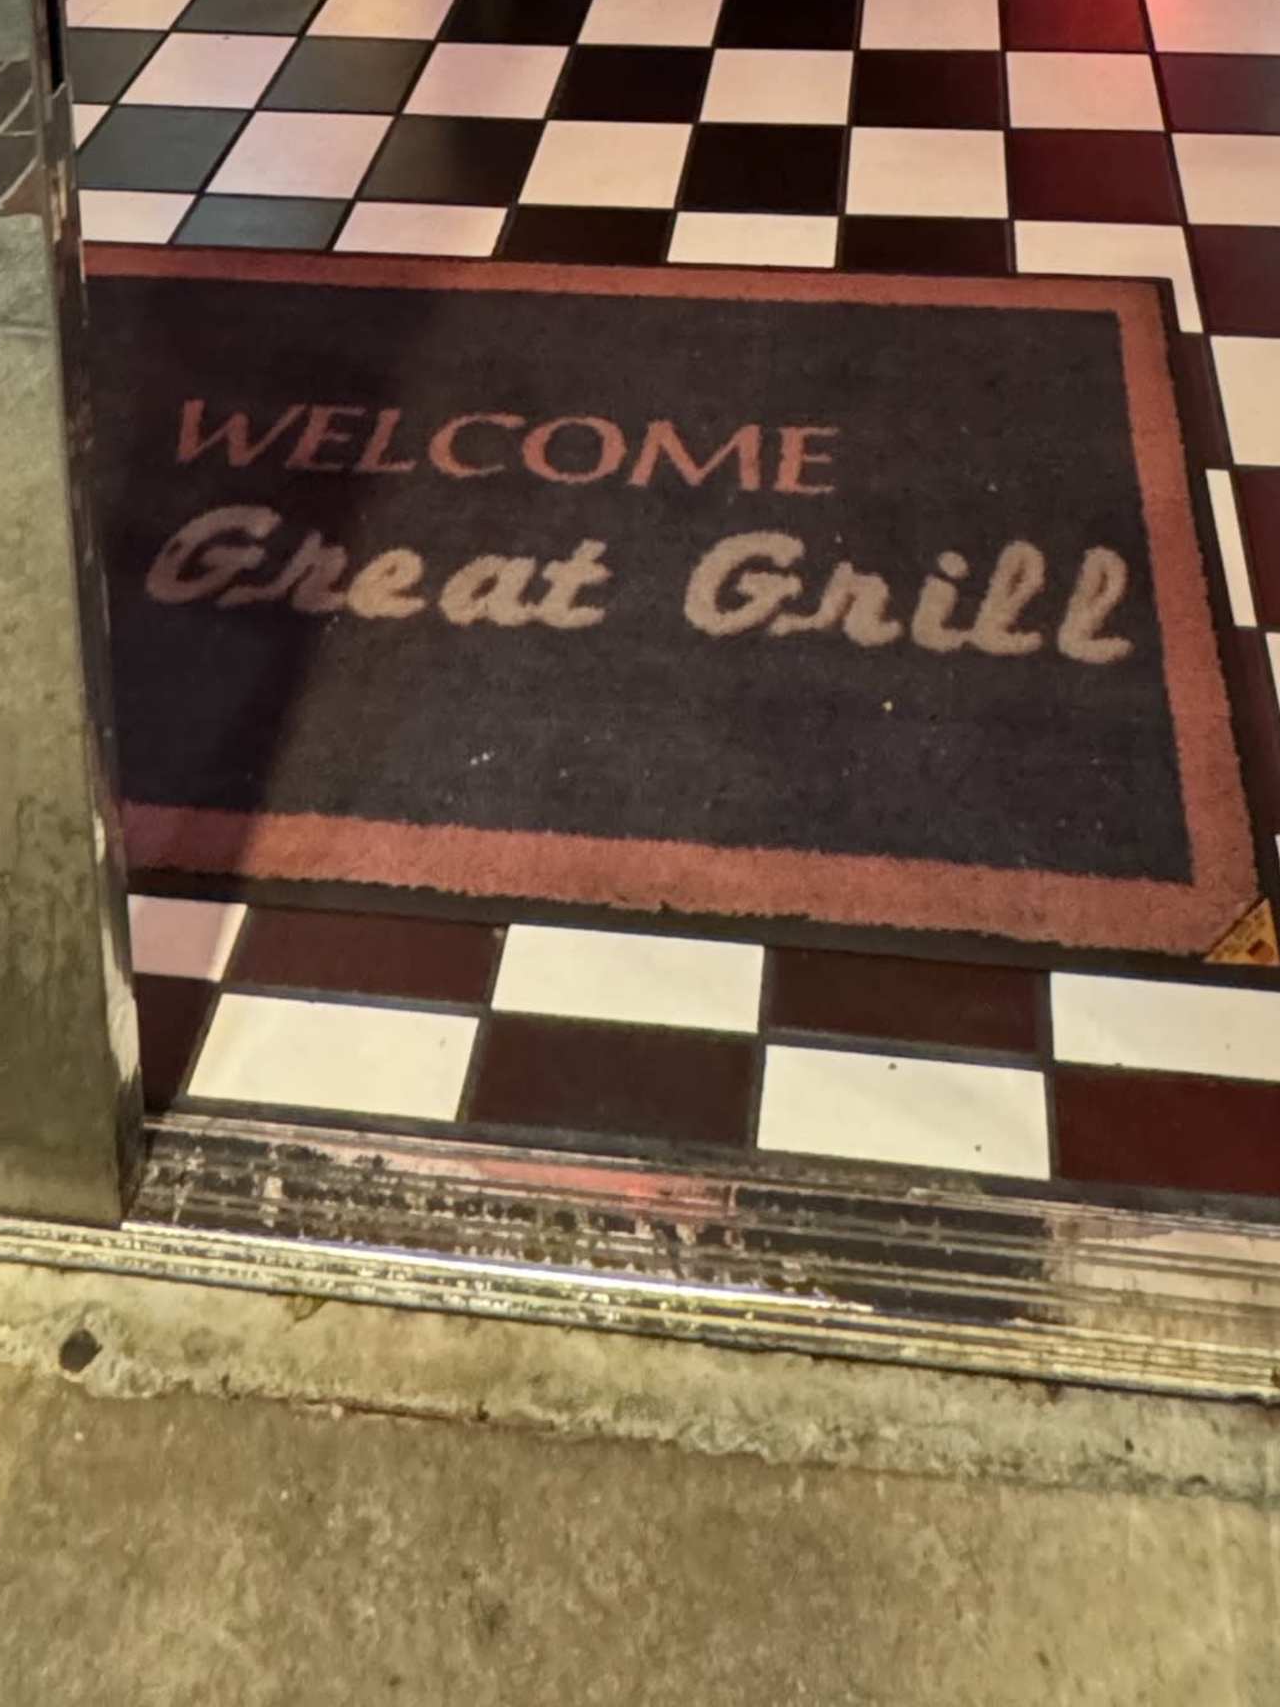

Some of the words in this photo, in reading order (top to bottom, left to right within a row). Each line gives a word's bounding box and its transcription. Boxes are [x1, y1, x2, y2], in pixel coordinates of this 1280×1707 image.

[174, 397, 841, 495] WELCOME
[145, 503, 613, 627] Great
[682, 532, 1133, 662] Grill
